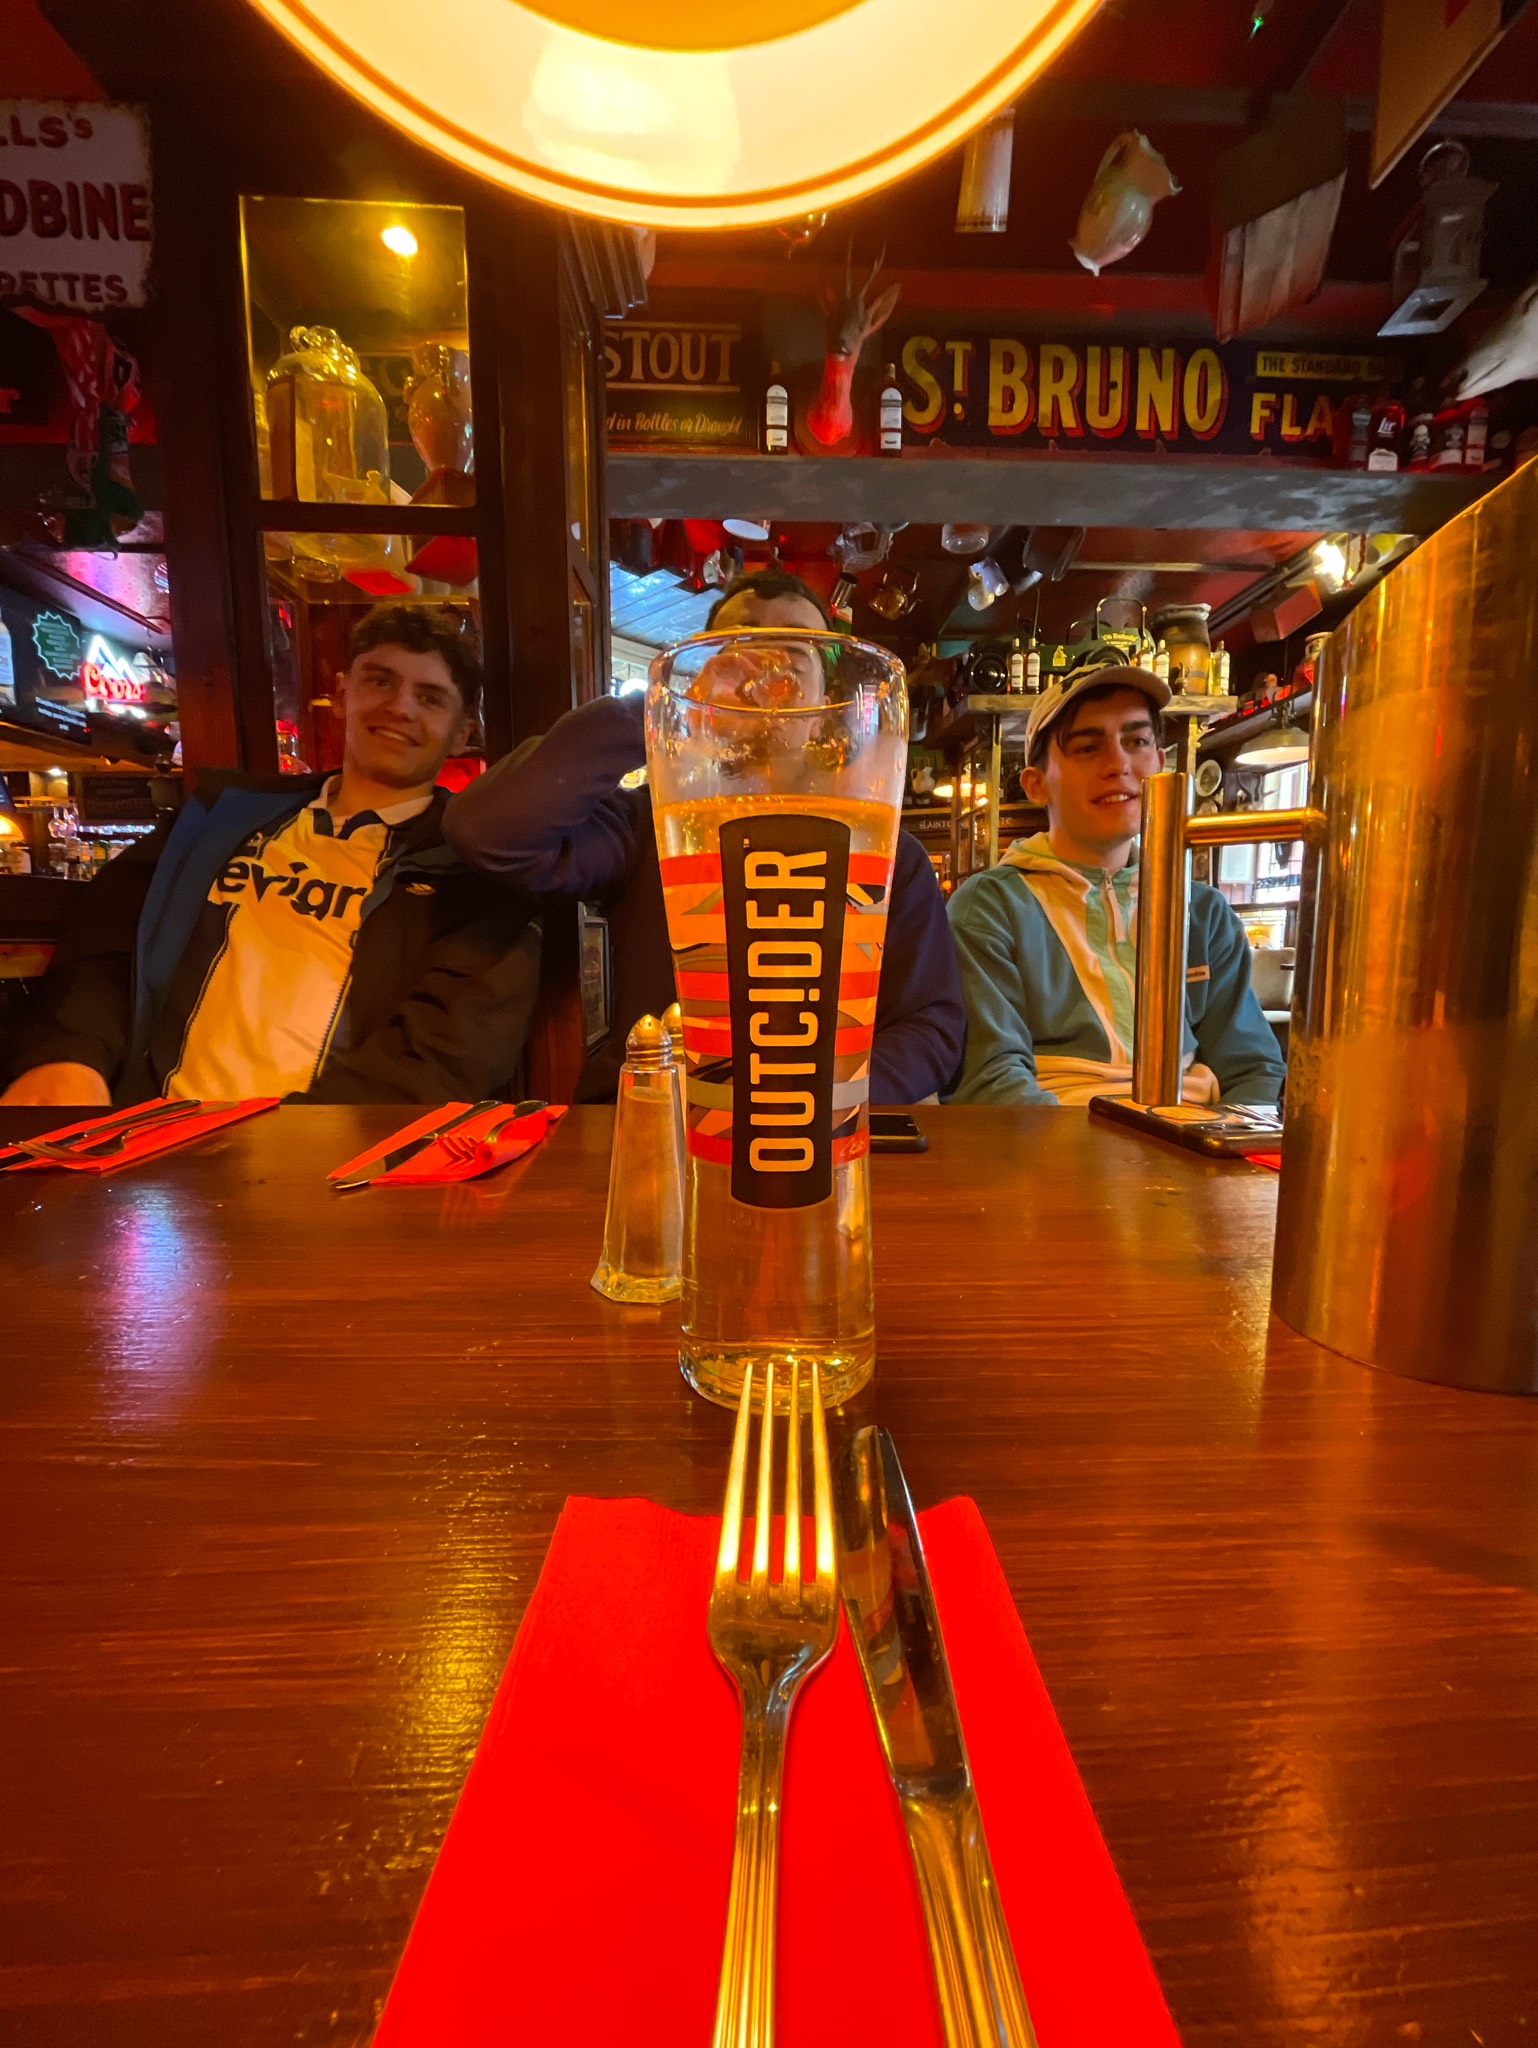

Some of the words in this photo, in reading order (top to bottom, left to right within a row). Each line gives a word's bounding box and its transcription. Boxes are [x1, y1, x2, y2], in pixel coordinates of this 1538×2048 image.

[605, 330, 742, 383] STOUT
[1262, 355, 1286, 372] THE
[987, 337, 1228, 440] BRUNO
[635, 411, 679, 432] Bottles
